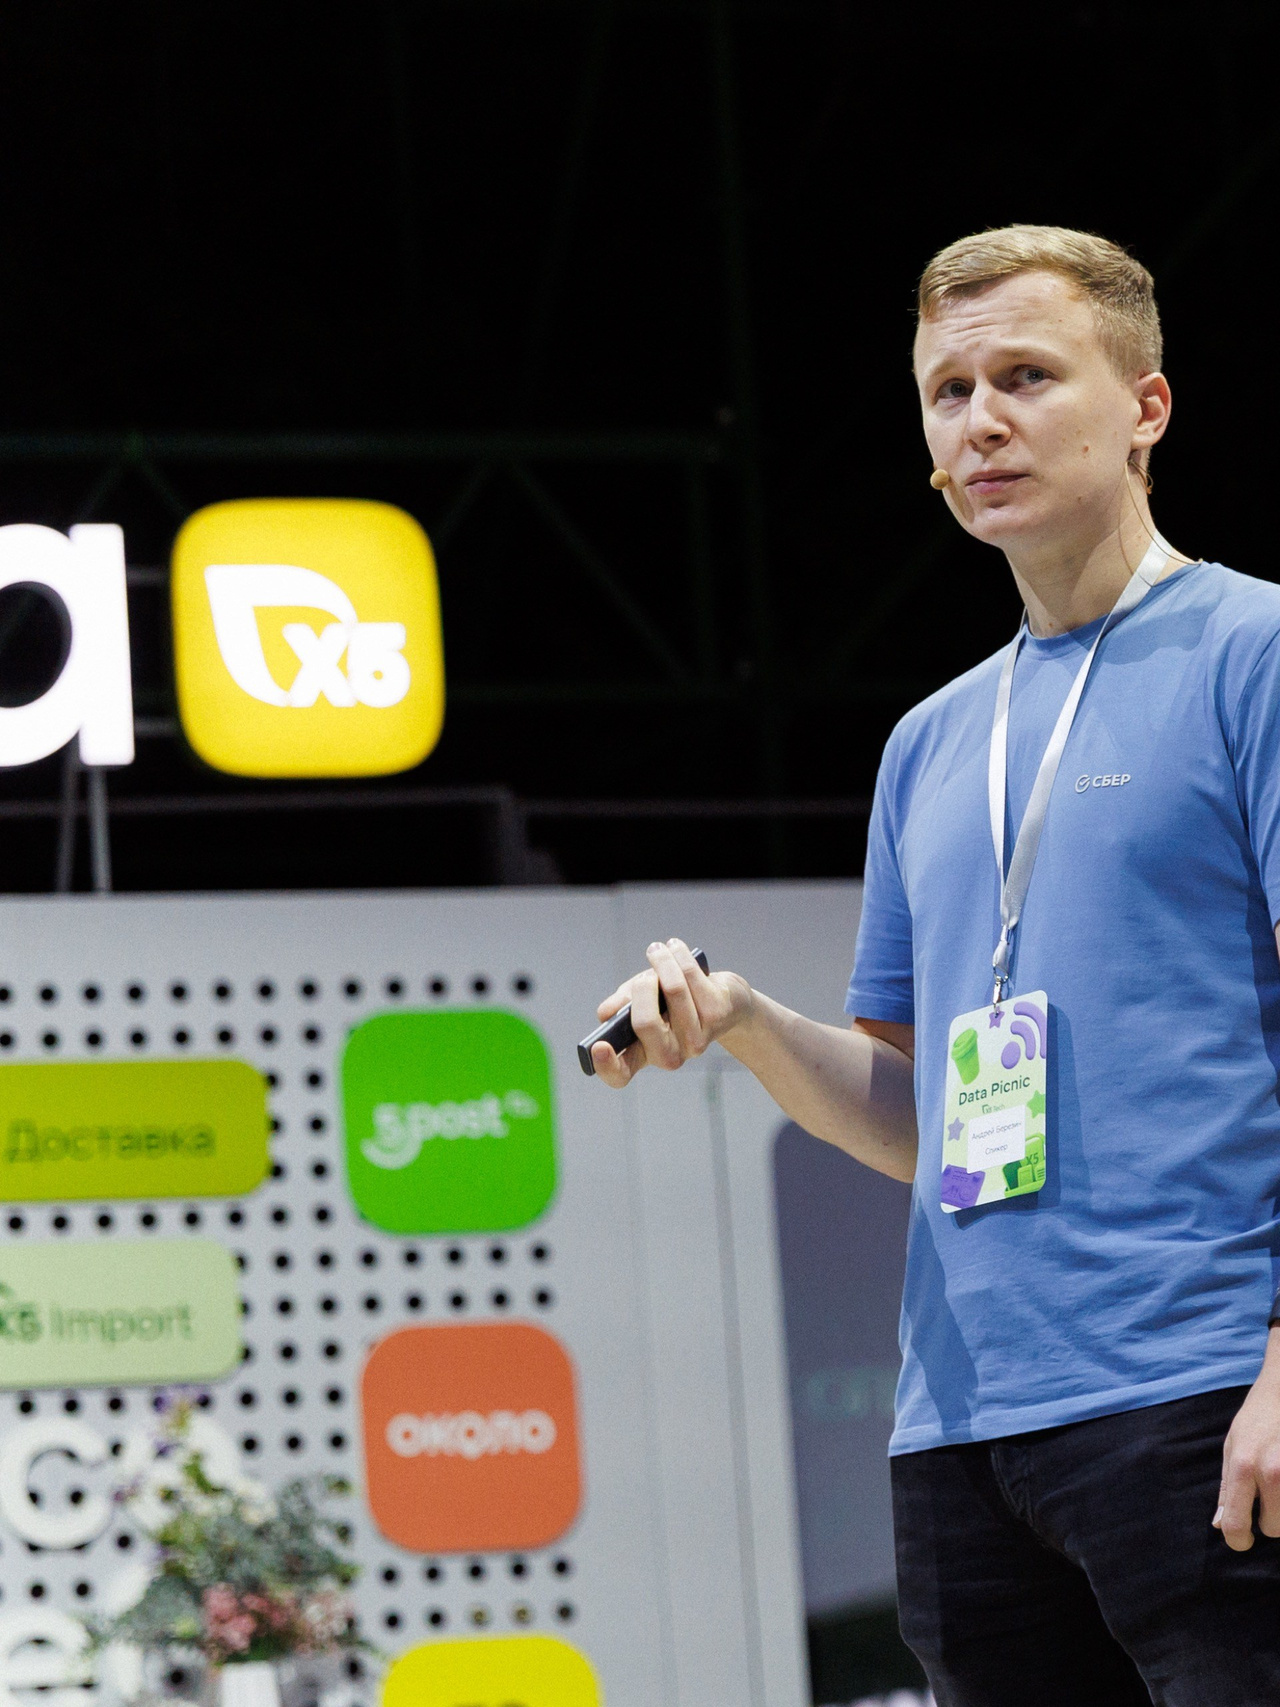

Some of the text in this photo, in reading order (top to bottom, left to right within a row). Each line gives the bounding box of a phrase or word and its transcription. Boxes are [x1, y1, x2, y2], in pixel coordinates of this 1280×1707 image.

[1092, 773, 1131, 788] СБЕР
[958, 1075, 1031, 1105] Data Picnic
[6, 1117, 216, 1164] Доставка
